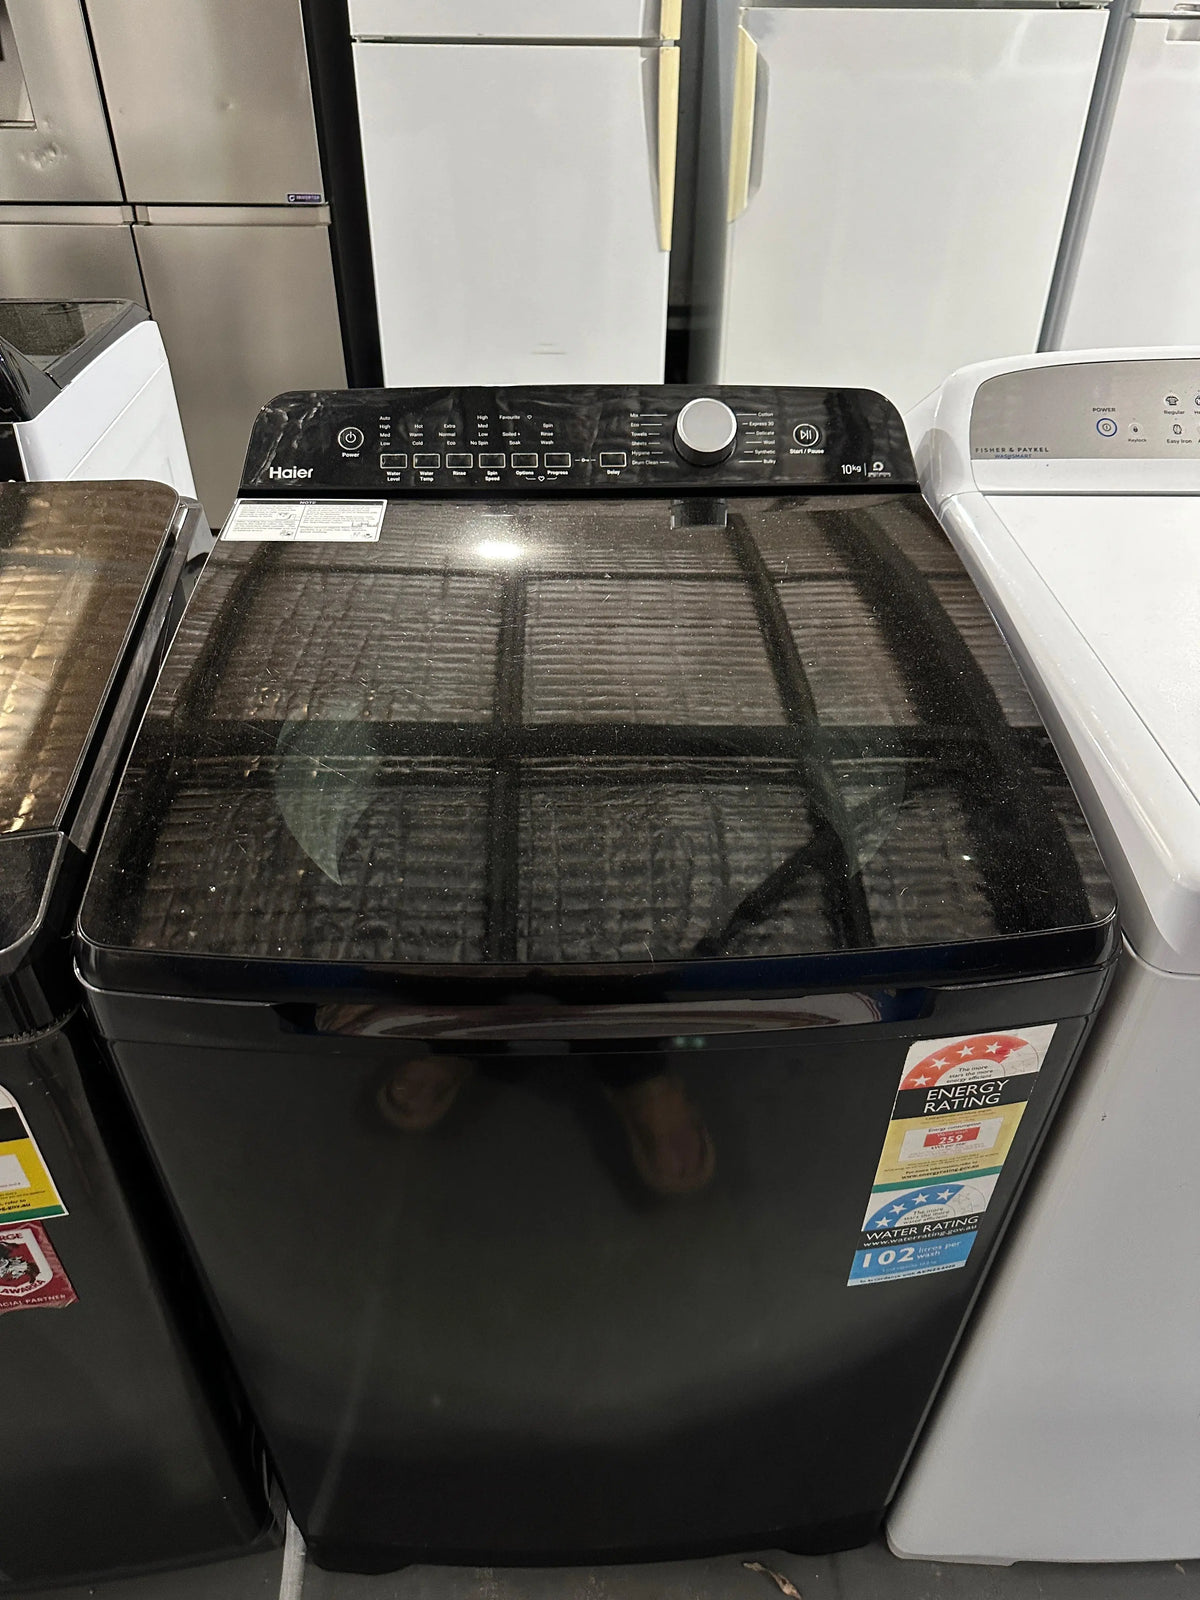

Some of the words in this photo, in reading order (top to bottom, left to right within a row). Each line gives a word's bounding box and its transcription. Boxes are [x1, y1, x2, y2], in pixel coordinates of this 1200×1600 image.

[269, 466, 314, 479] Haier
[841, 463, 862, 475] 10kg
[926, 1079, 1010, 1101] ENERGY
[923, 1093, 1001, 1114] RATING
[947, 1122, 982, 1130] consumption
[938, 1134, 963, 1145] 259
[901, 1165, 980, 1180] www.energyrating.gov.au
[866, 1227, 918, 1241] WATER
[922, 1215, 980, 1233] RATING
[863, 1225, 977, 1247] www.waterrating.gov.au
[944, 1241, 961, 1250] per
[862, 1247, 915, 1268] 102
[917, 1251, 941, 1259] wash
[25, 1294, 66, 1304] PARTNER
